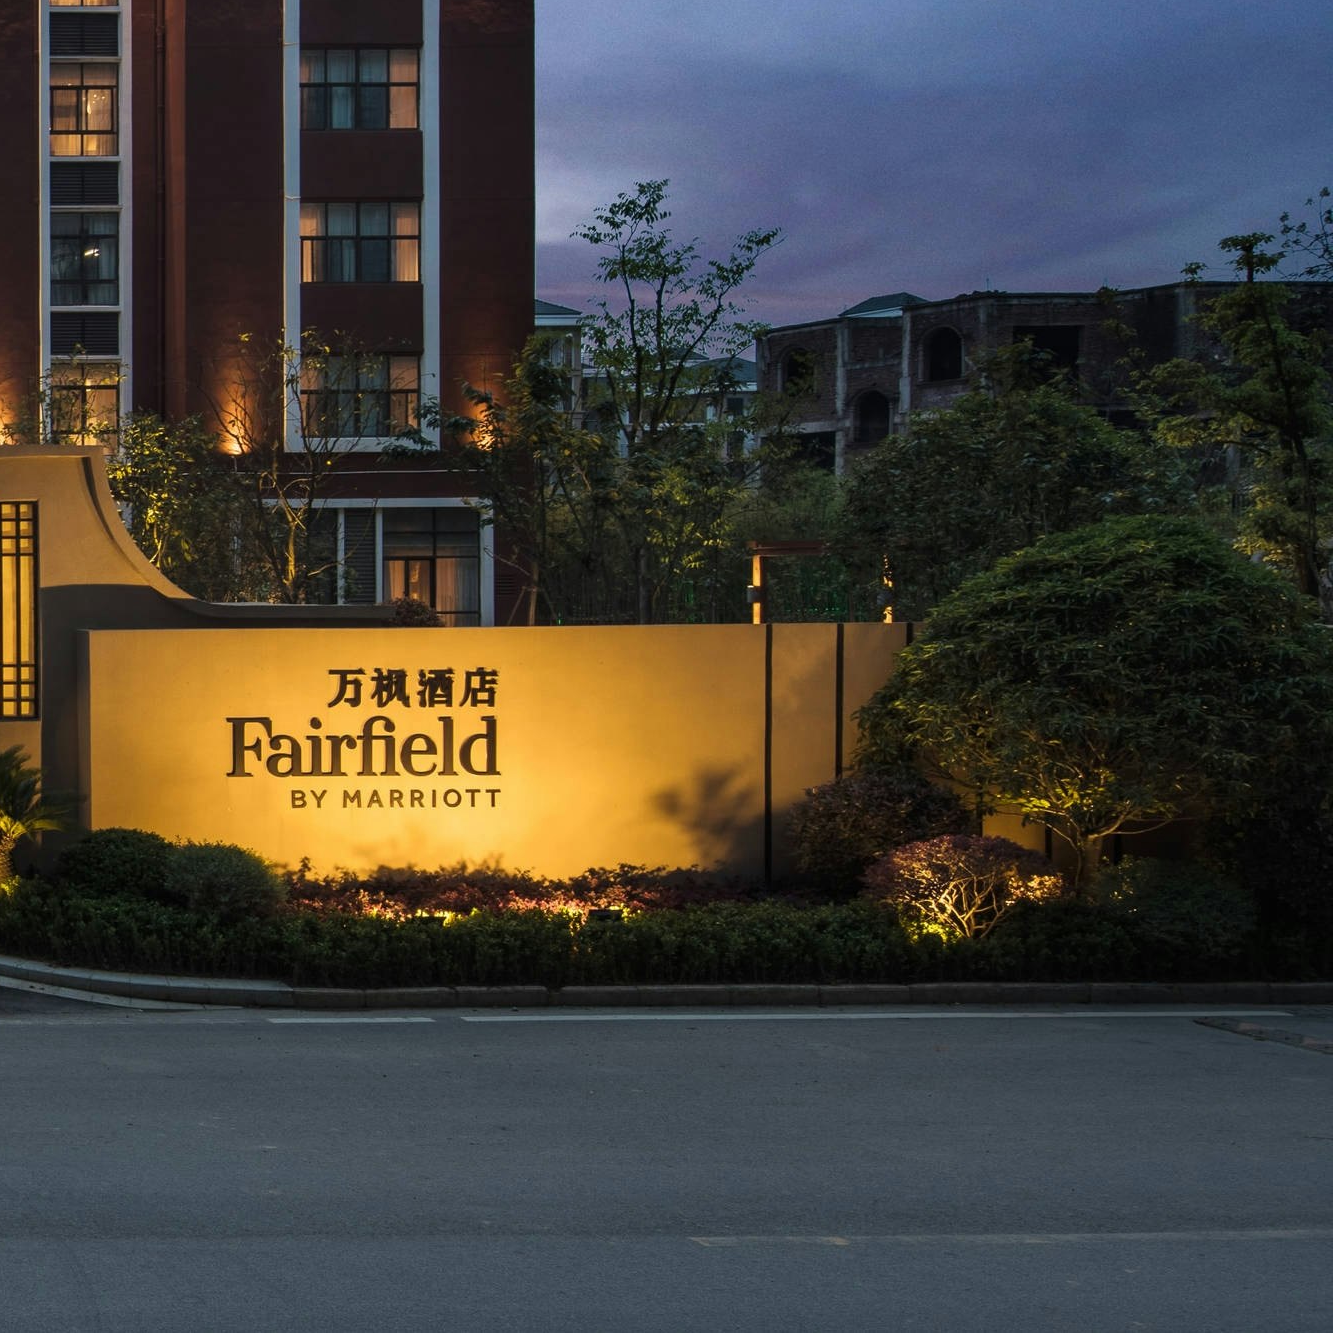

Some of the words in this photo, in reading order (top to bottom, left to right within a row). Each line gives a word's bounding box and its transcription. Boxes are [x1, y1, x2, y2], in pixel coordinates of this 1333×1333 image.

[327, 667, 499, 708] 万枫酒店
[225, 716, 501, 778] Fairfield
[290, 789, 328, 809] BY
[341, 788, 502, 809] MARRIOTT
